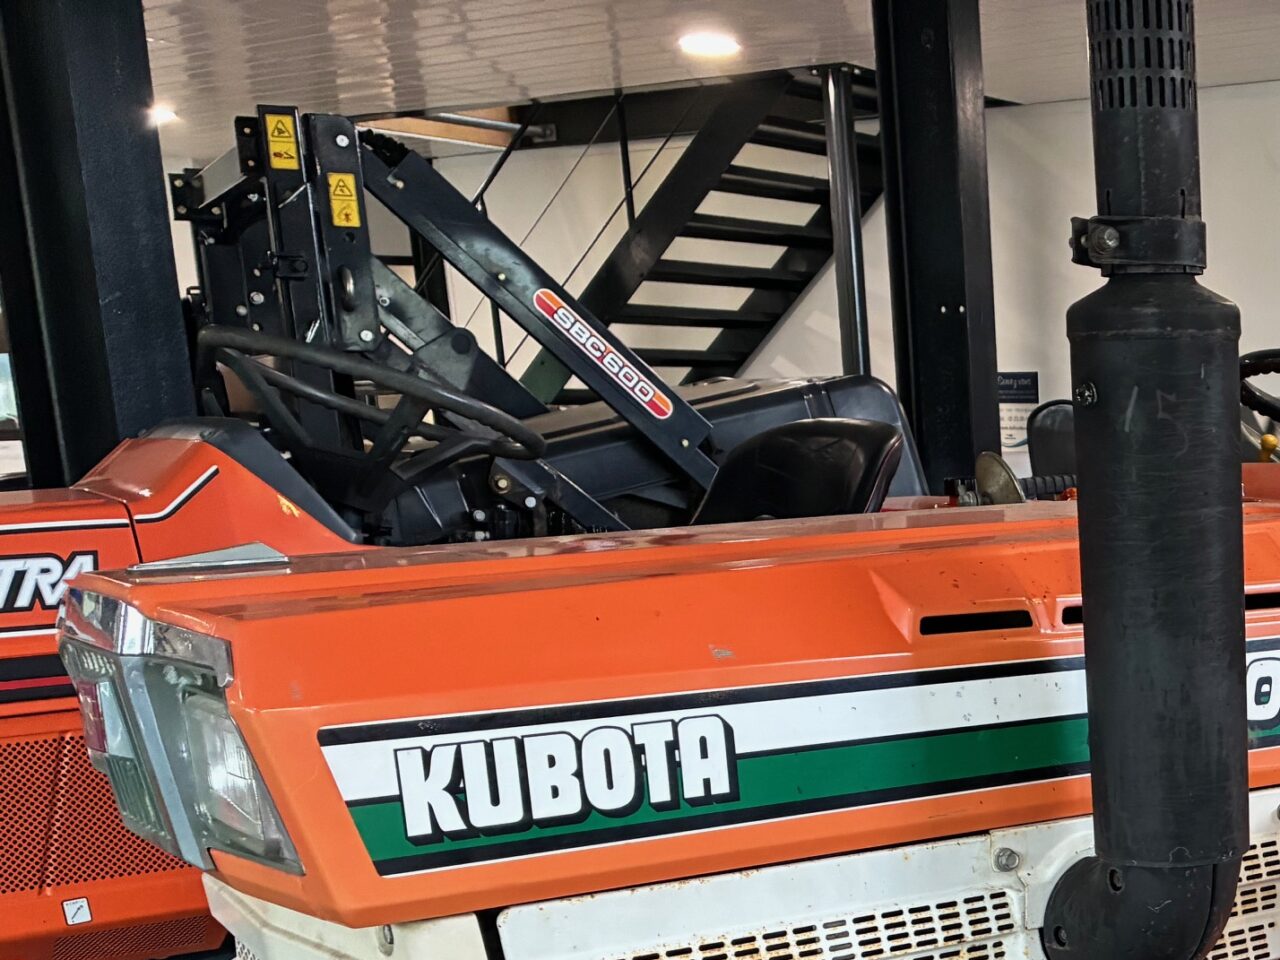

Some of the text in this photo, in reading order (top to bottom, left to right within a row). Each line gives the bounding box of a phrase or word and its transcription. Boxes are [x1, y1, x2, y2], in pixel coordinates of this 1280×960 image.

[553, 306, 655, 403] SBC 600
[396, 714, 738, 844] KUBOTA
